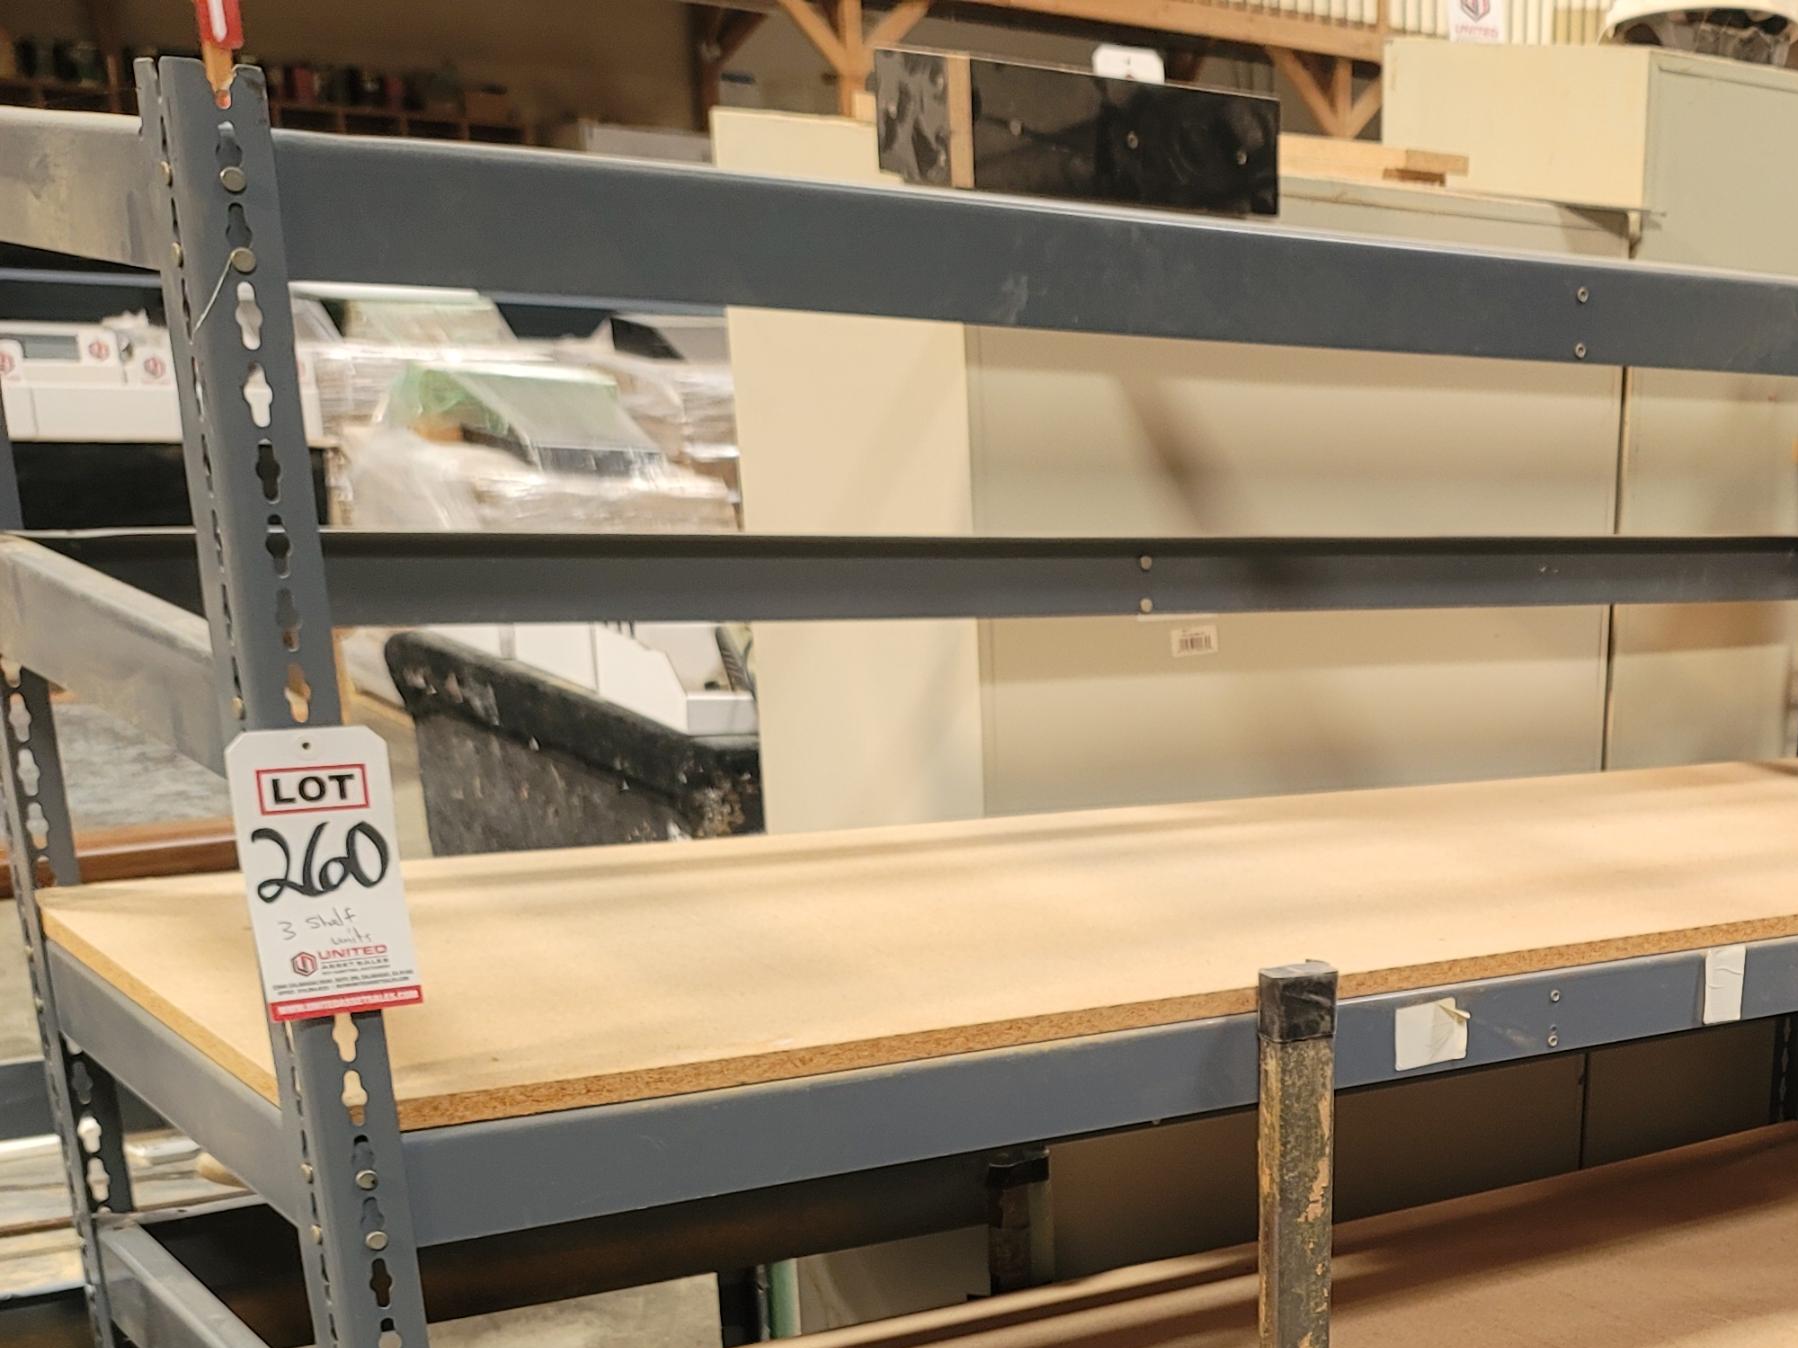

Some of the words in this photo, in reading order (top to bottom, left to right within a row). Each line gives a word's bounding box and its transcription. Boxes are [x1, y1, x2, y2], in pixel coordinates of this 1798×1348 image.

[272, 774, 355, 805] LOT
[251, 820, 389, 904] 260
[277, 921, 297, 940] 3
[318, 944, 388, 960] UNITED
